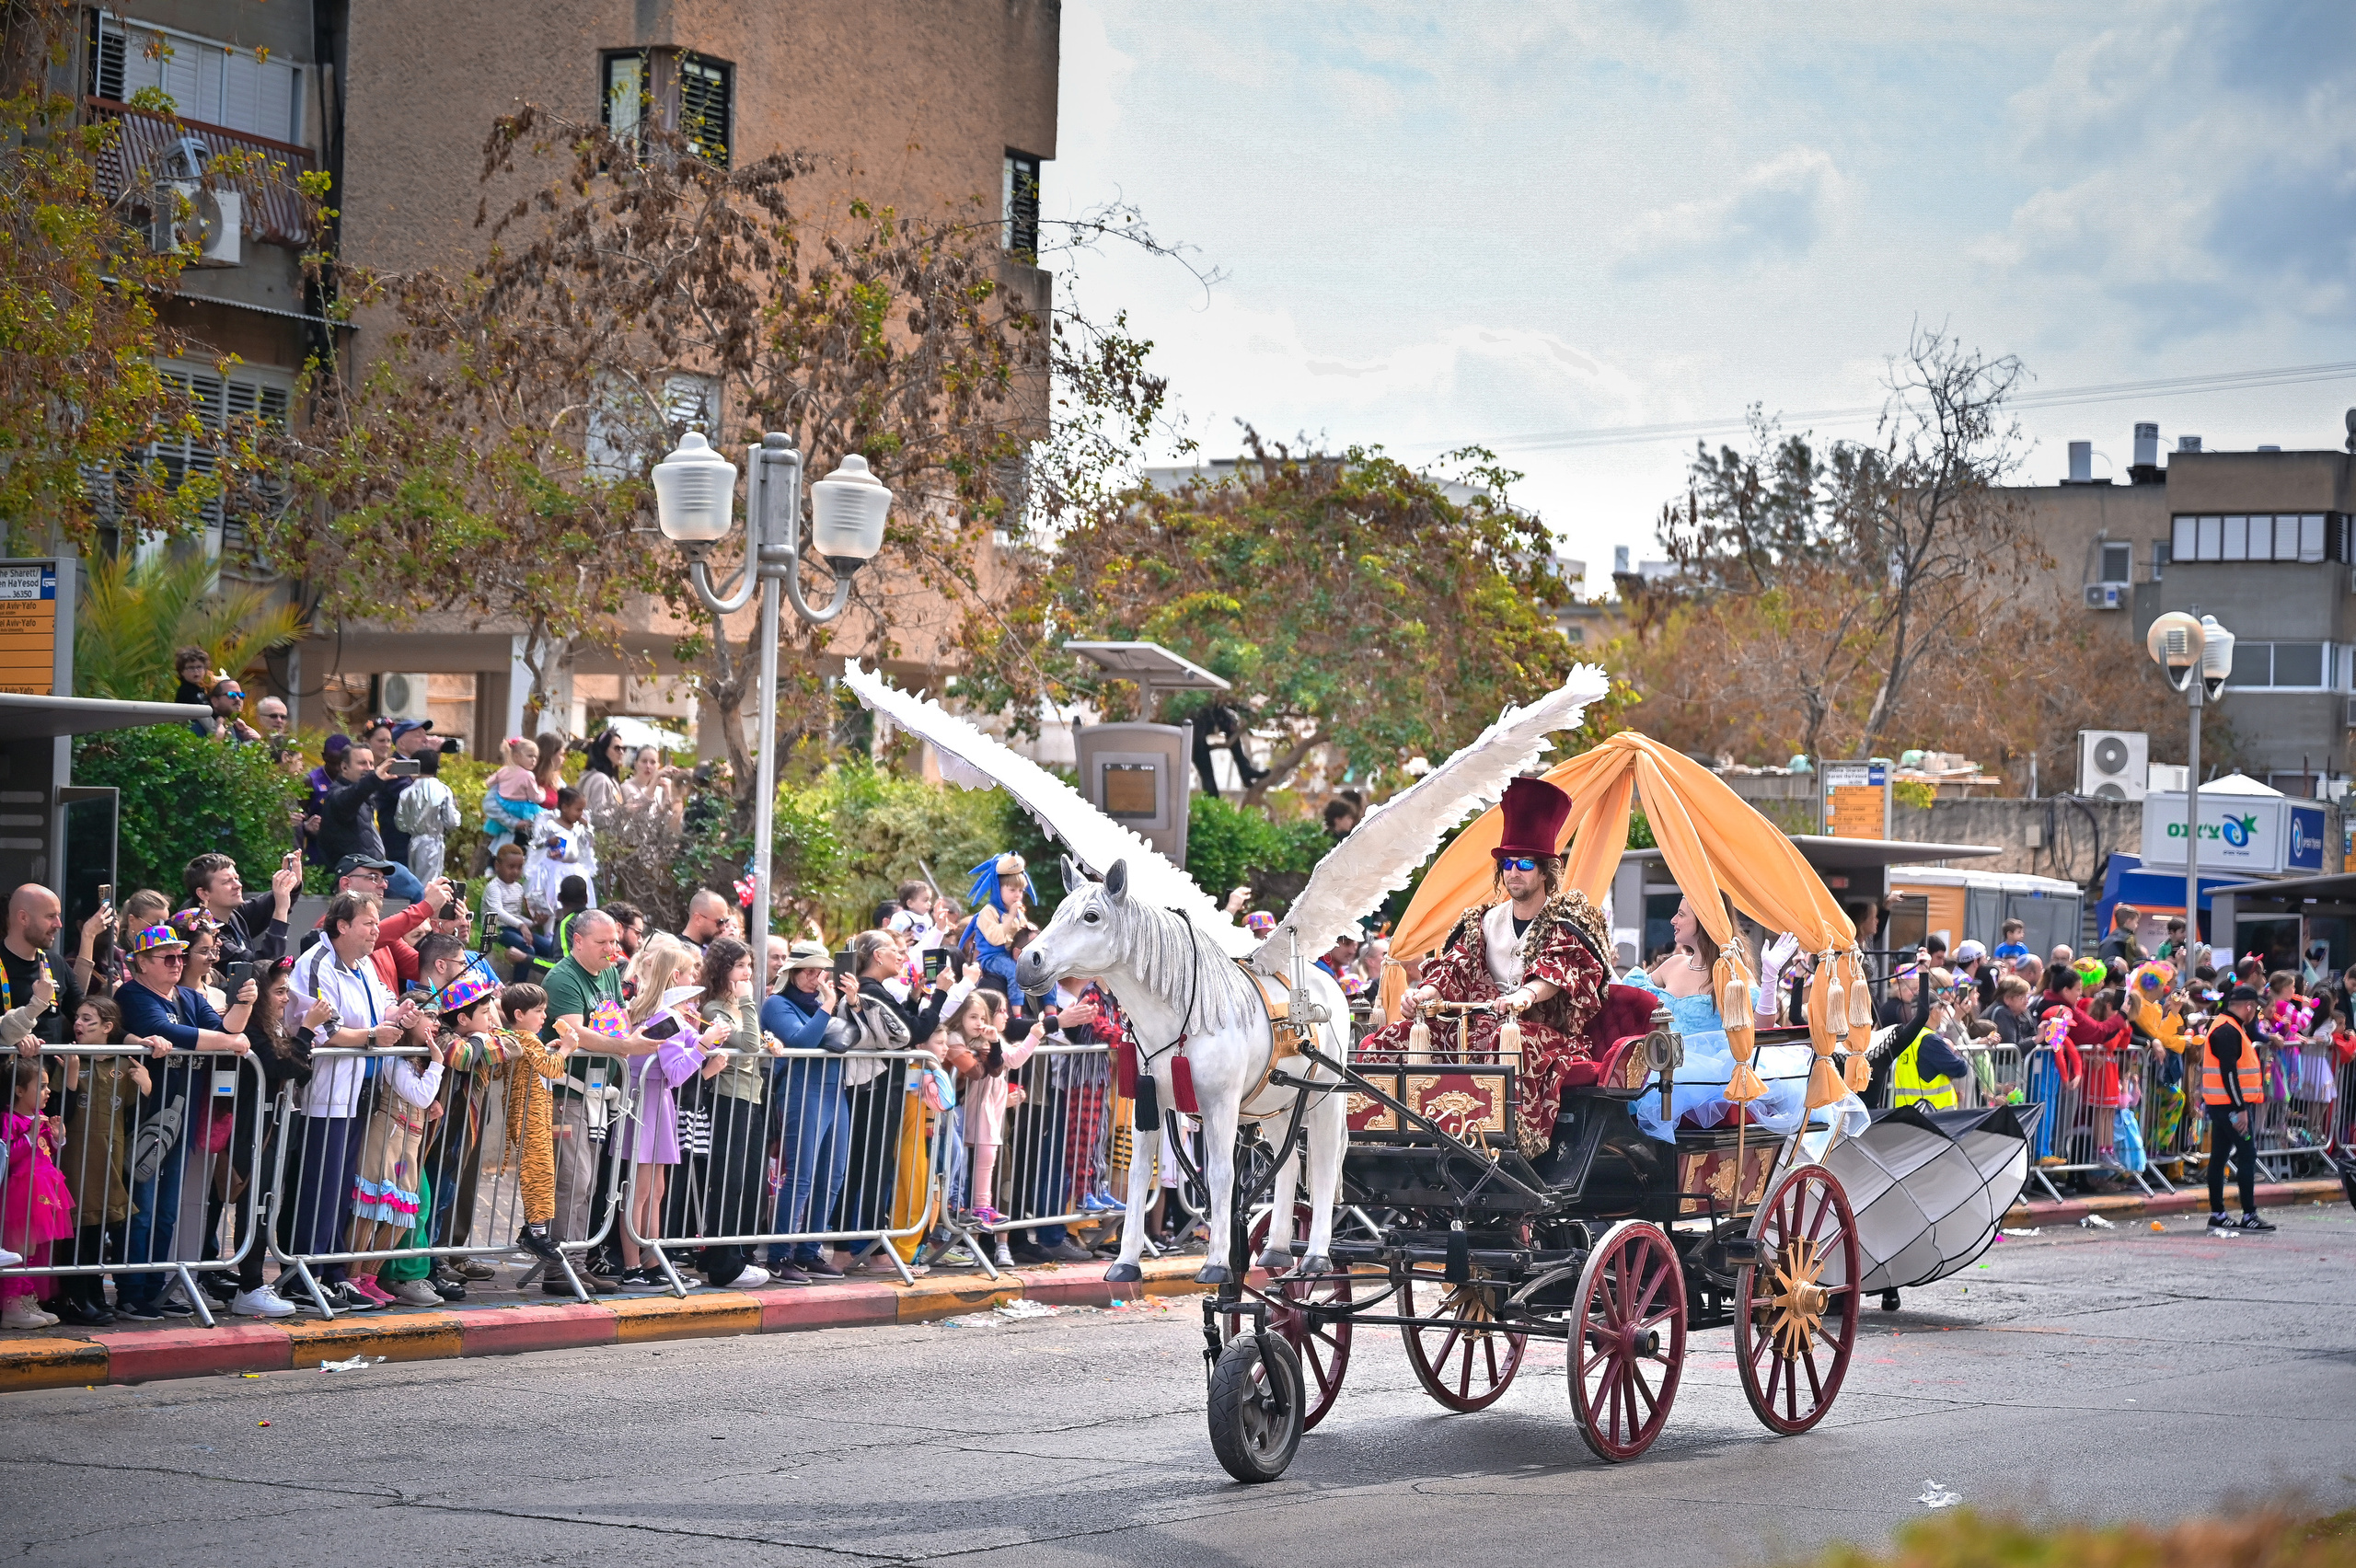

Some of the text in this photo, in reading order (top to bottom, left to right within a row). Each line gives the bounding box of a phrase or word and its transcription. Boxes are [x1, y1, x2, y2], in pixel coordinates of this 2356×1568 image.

[10, 569, 40, 578] Sharett/
[8, 579, 39, 588] HaYesod
[13, 590, 32, 598] 36350
[6, 602, 37, 610] Aviv-Yafo
[6, 618, 37, 627] Aviv-Yafo
